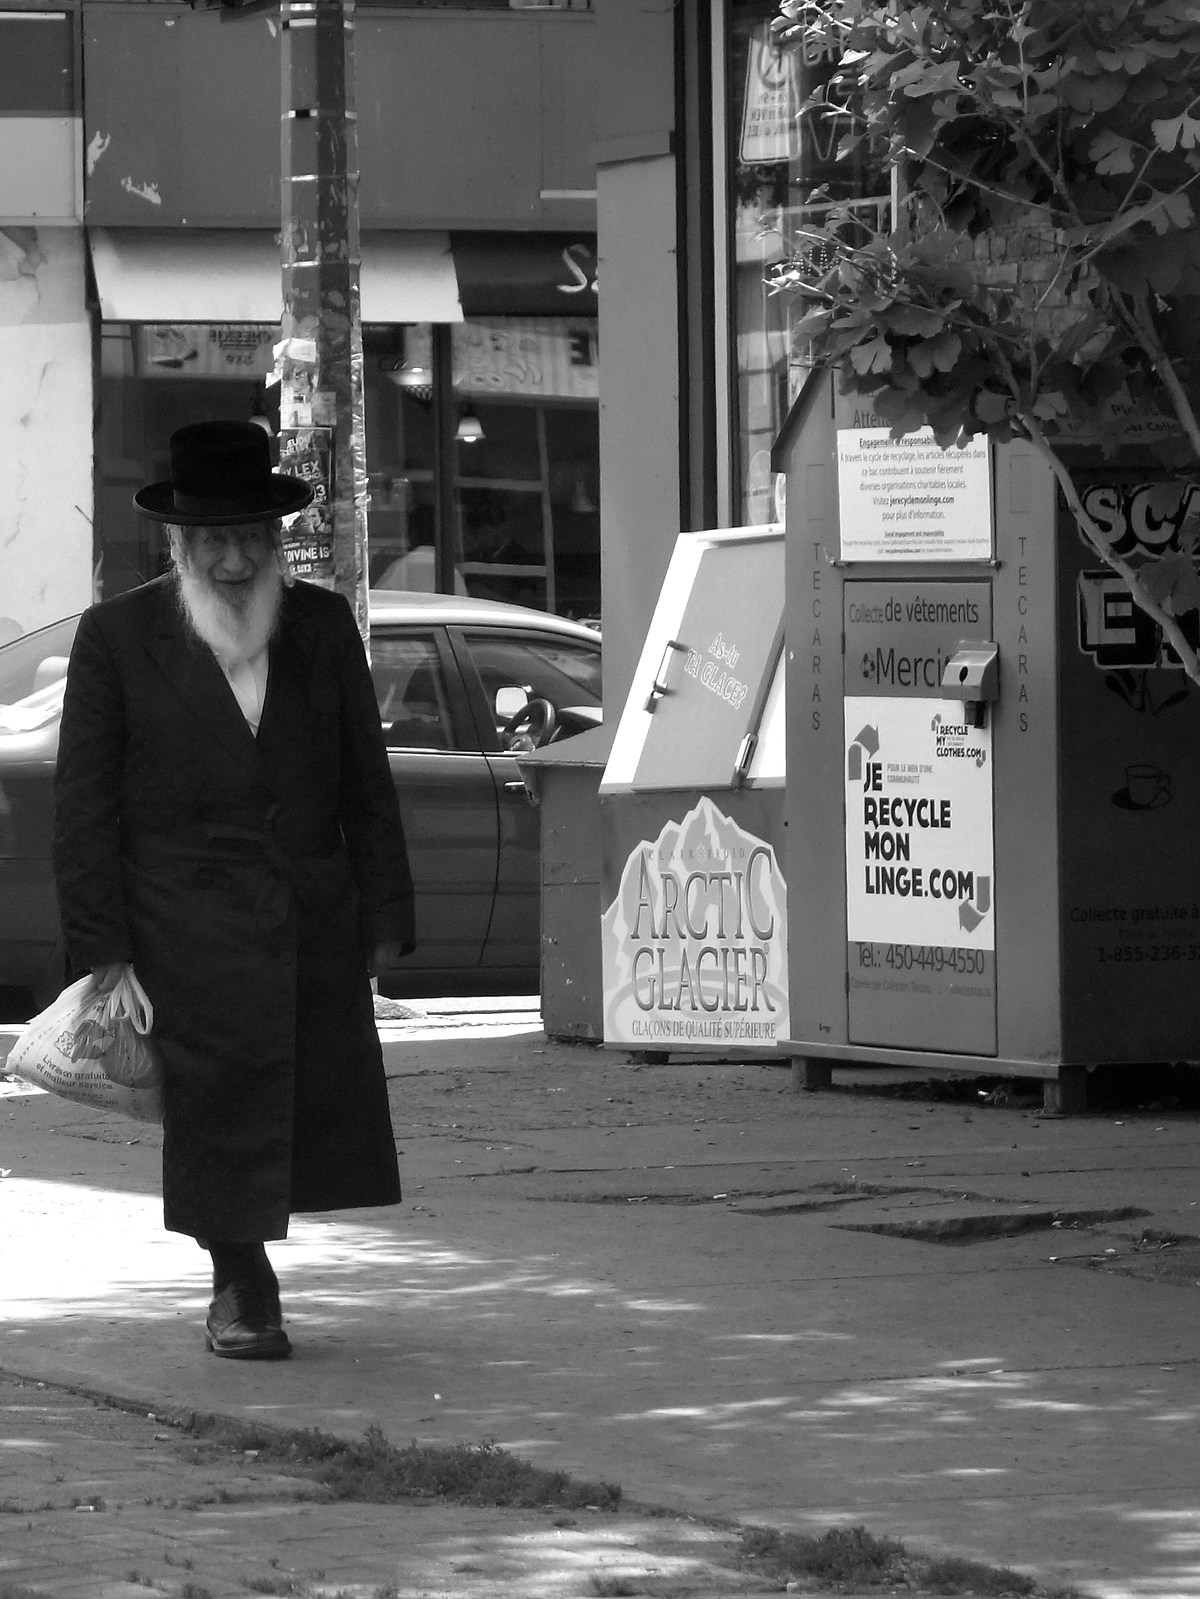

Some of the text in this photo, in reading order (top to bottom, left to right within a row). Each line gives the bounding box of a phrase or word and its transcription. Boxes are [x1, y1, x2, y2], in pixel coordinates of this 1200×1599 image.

[890, 494, 954, 507] jerecyclemonlinge.com
[849, 595, 979, 624] Collecte de vêtements
[876, 647, 941, 687] Merci
[936, 736, 946, 746] MY
[940, 725, 968, 735] RECYCLE
[936, 747, 981, 757] CLOTHES.COM
[863, 762, 883, 793] JE
[863, 797, 951, 829] RECYCLE
[864, 831, 910, 861] MON
[631, 845, 774, 940] ARCTIC
[865, 866, 974, 900] LINGE.COM
[885, 944, 985, 974] 450-449-4550
[632, 946, 775, 1012] GLACIER
[632, 1018, 775, 1040] GLAÇONS DE QUALITÉ SUPÉRIEURE
[79, 1081, 113, 1090] service
